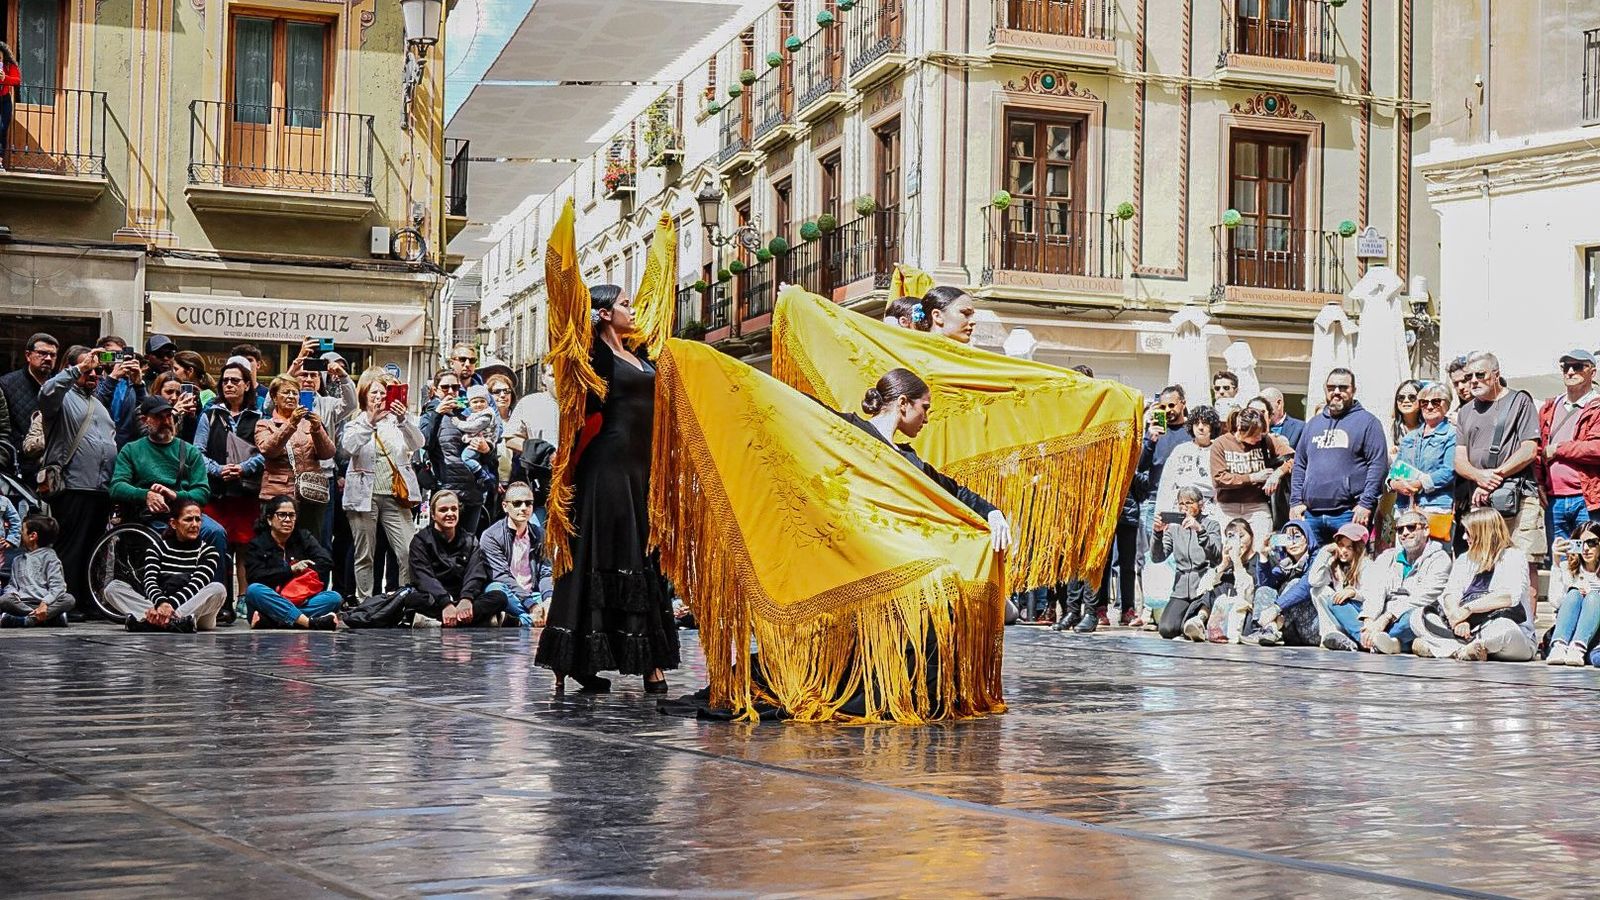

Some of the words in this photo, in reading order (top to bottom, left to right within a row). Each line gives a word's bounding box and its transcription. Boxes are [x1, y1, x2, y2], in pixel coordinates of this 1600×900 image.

[1011, 34, 1043, 46] CASA
[1055, 38, 1112, 53] CATEDRAL
[1010, 275, 1044, 286] CASA
[1058, 277, 1118, 292] CATEDRAL
[176, 306, 301, 330] CUCHILLERÍA
[306, 313, 350, 333] RUIZ
